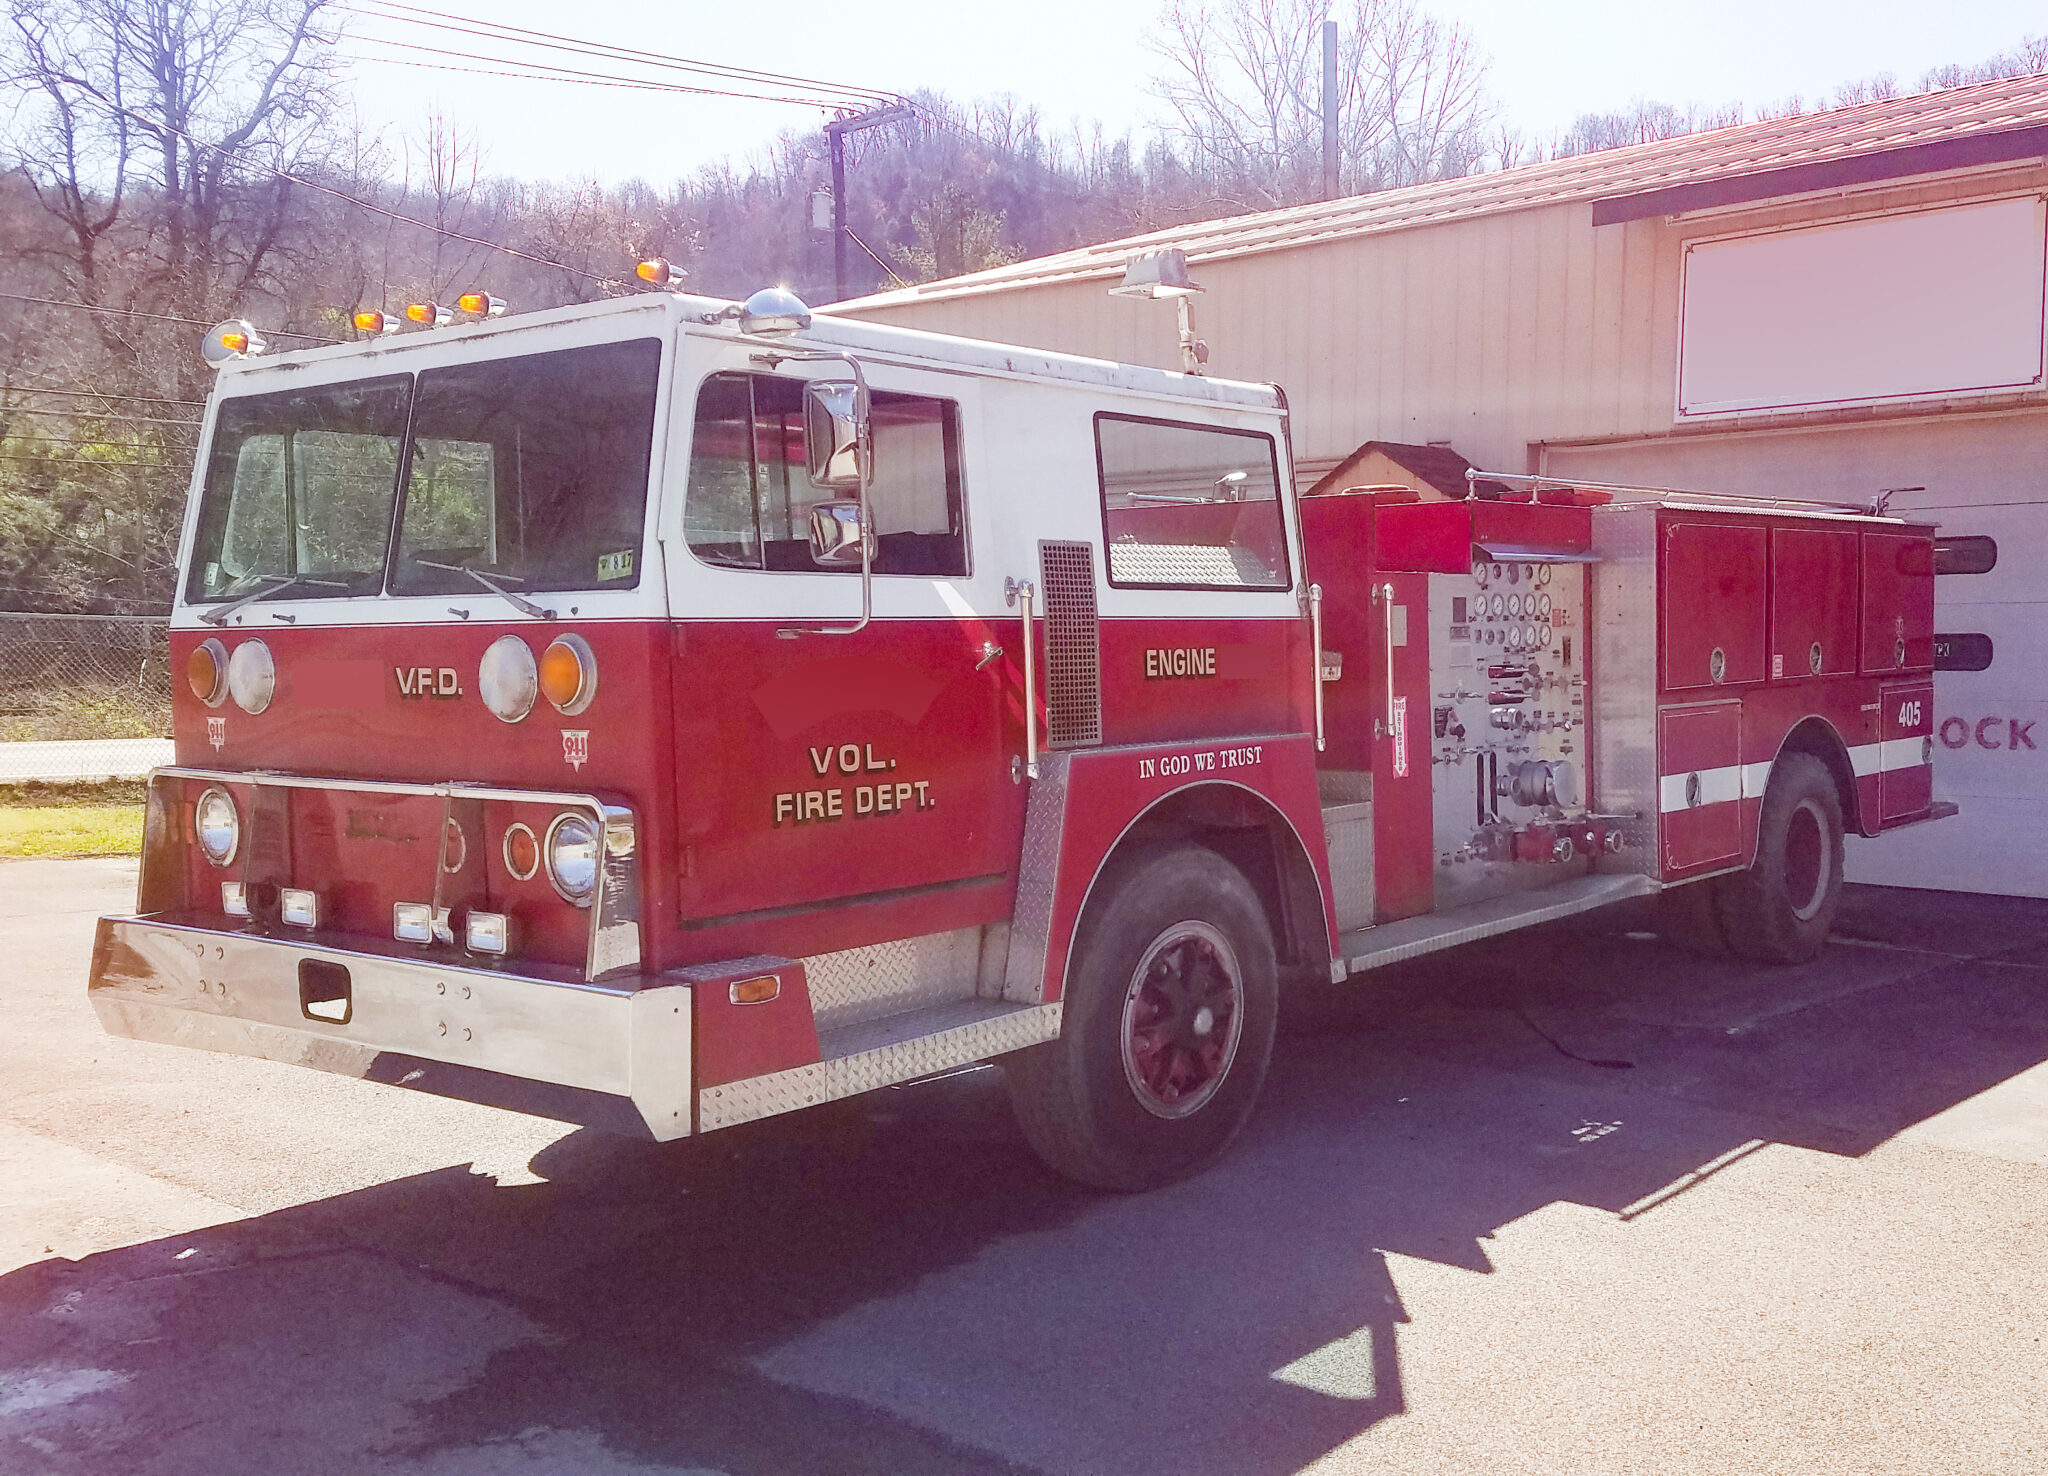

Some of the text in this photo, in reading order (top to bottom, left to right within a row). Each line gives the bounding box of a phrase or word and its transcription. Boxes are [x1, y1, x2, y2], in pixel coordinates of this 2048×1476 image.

[1145, 648, 1216, 677] ENGINE
[395, 667, 463, 695] V.F.D.
[1898, 701, 1921, 728] 405
[810, 743, 896, 774] VOL.
[1139, 746, 1263, 779] IN GOD WE TRUST
[776, 780, 936, 822] FIRE DEPT.
